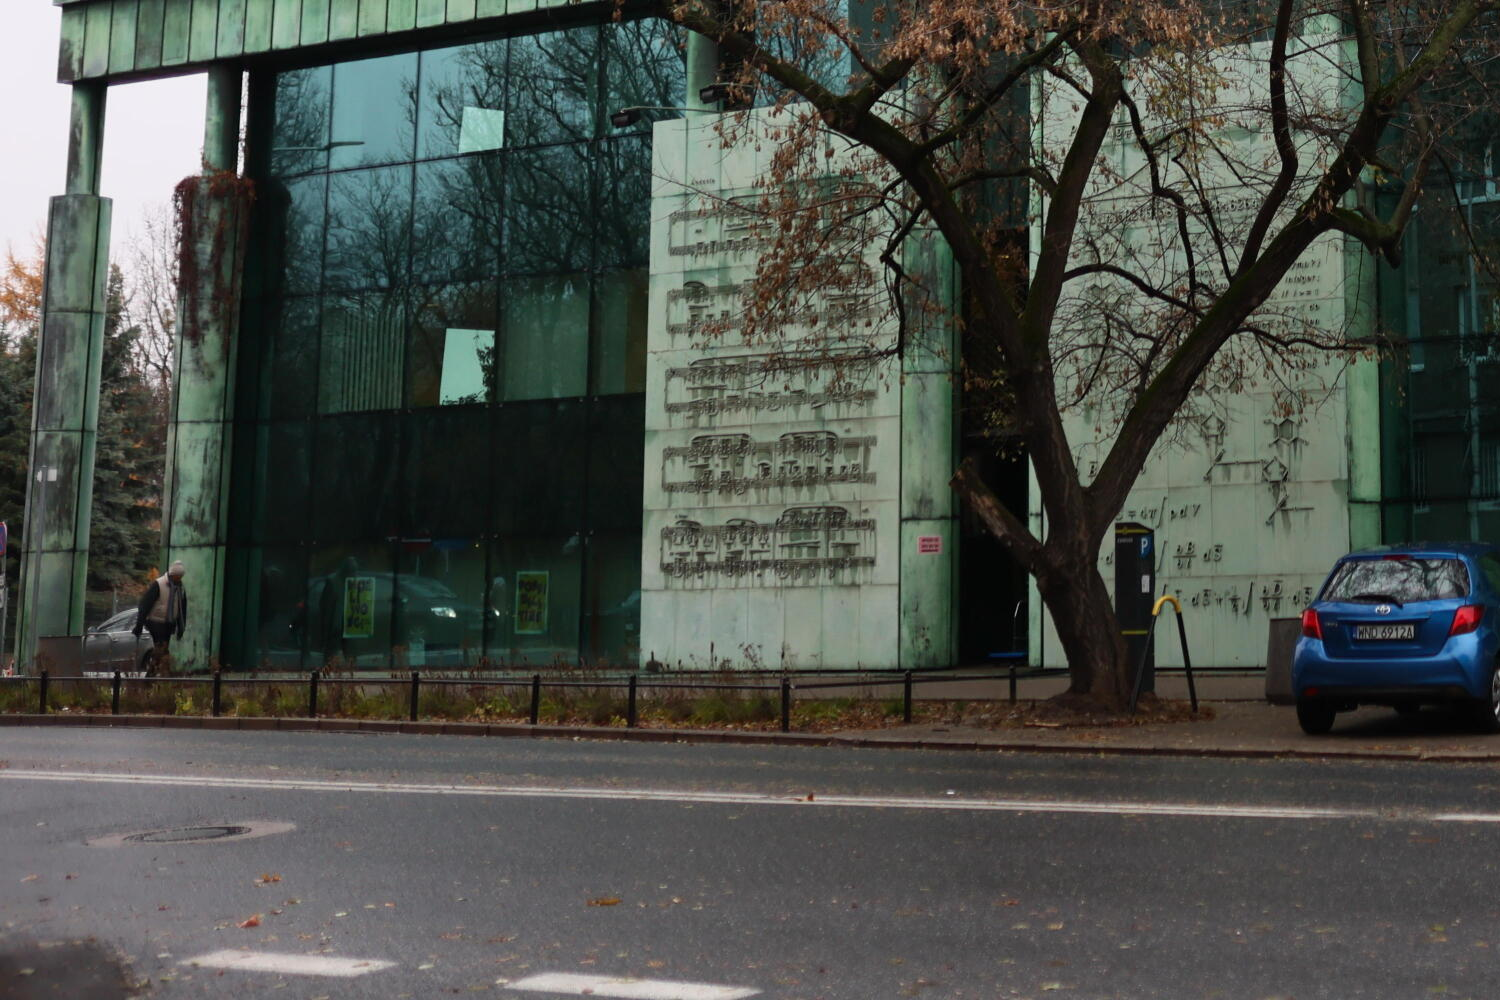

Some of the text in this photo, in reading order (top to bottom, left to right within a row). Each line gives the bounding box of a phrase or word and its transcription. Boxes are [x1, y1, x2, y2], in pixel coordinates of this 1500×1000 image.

[1141, 537, 1149, 555] P
[1357, 625, 1413, 639] WND 6912A
